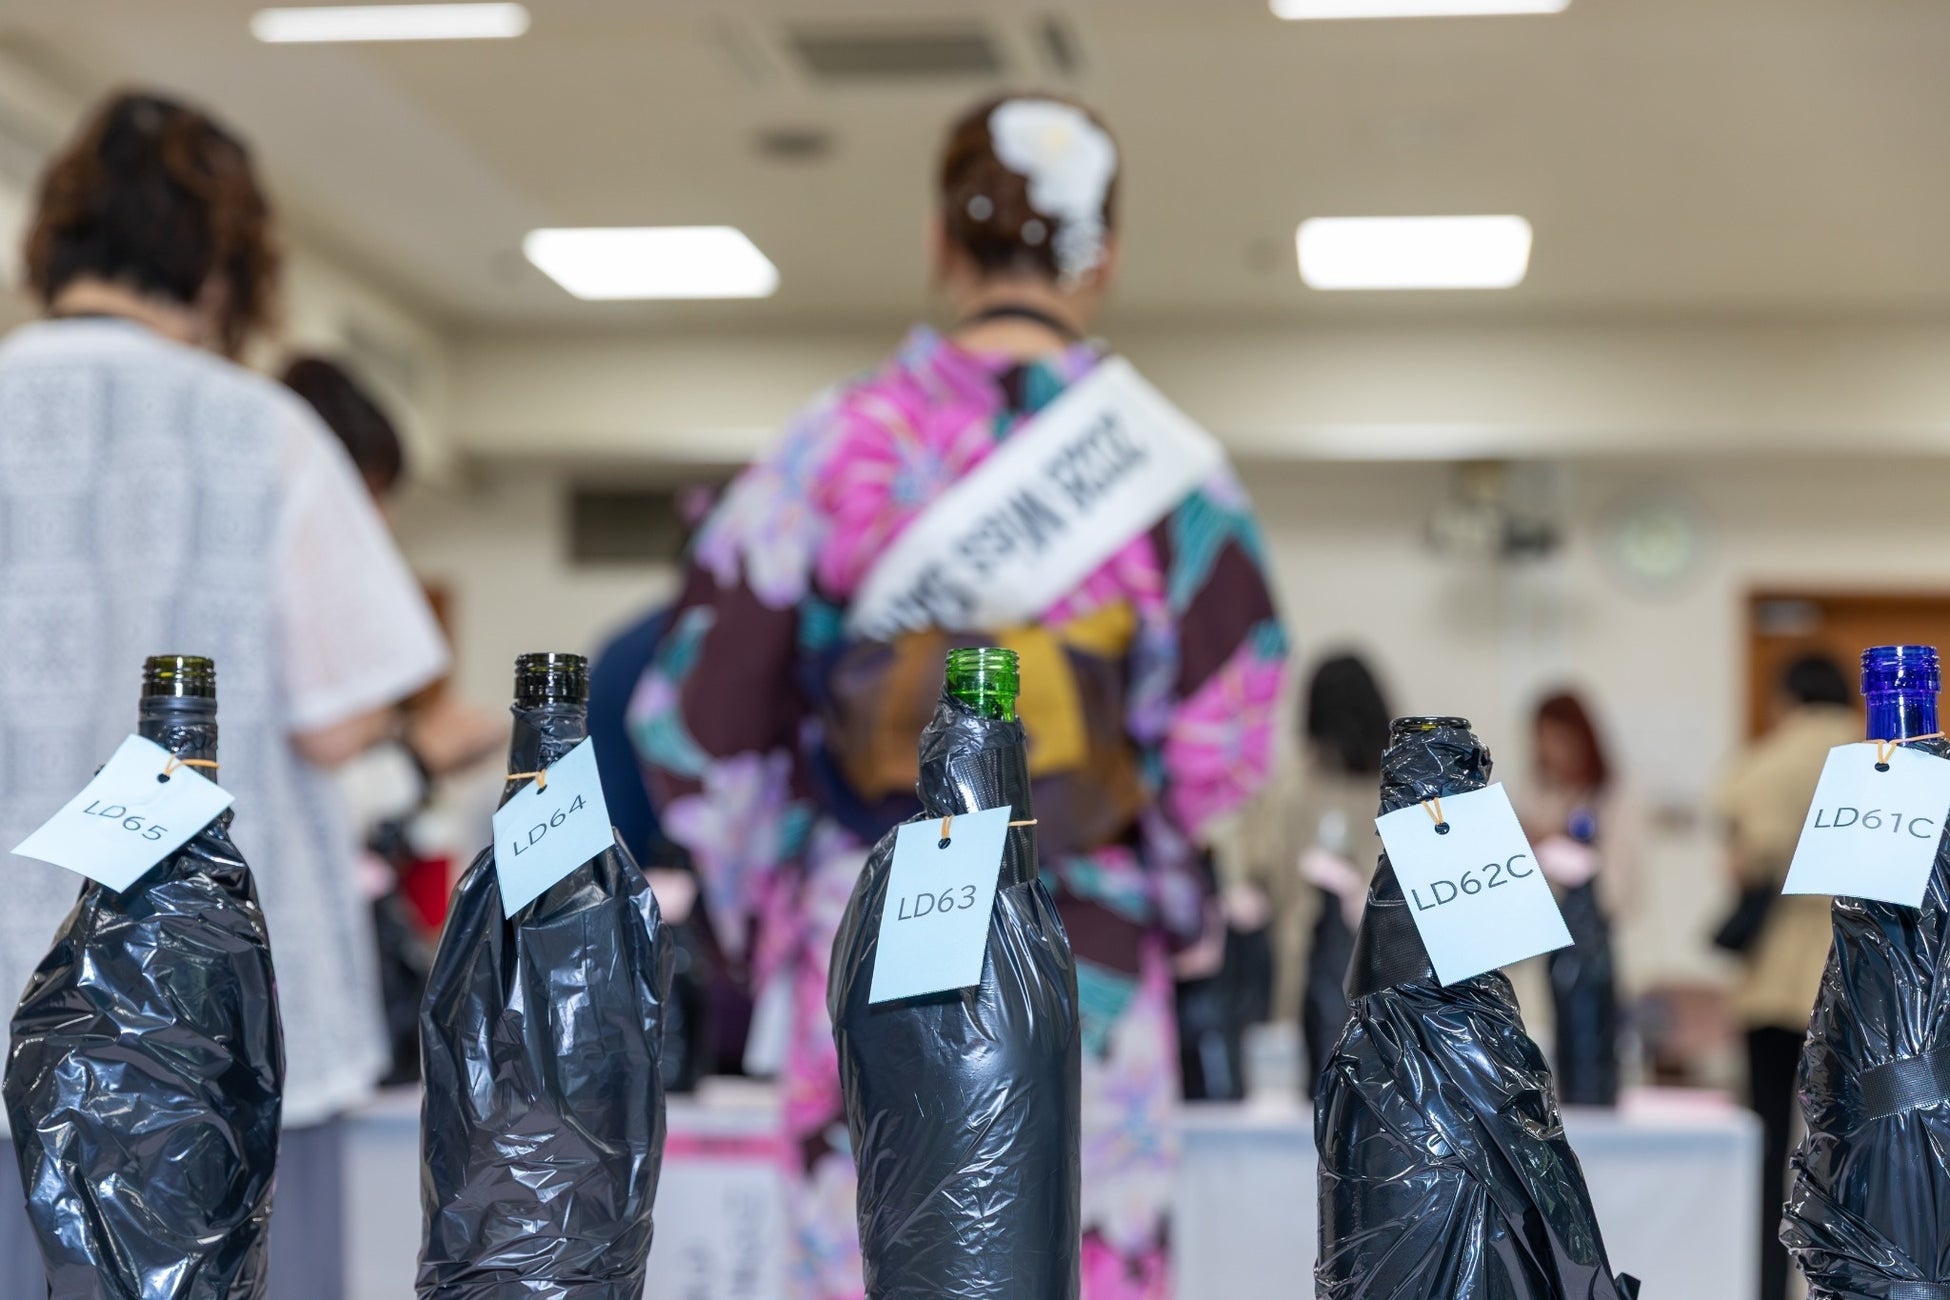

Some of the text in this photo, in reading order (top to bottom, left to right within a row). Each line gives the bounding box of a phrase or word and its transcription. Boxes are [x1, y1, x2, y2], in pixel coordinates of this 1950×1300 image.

[82, 800, 168, 841] LD65
[512, 794, 587, 857] LD64
[1813, 806, 1935, 839] LD61C
[897, 884, 977, 921] LD63
[1411, 853, 1534, 912] LD62C
